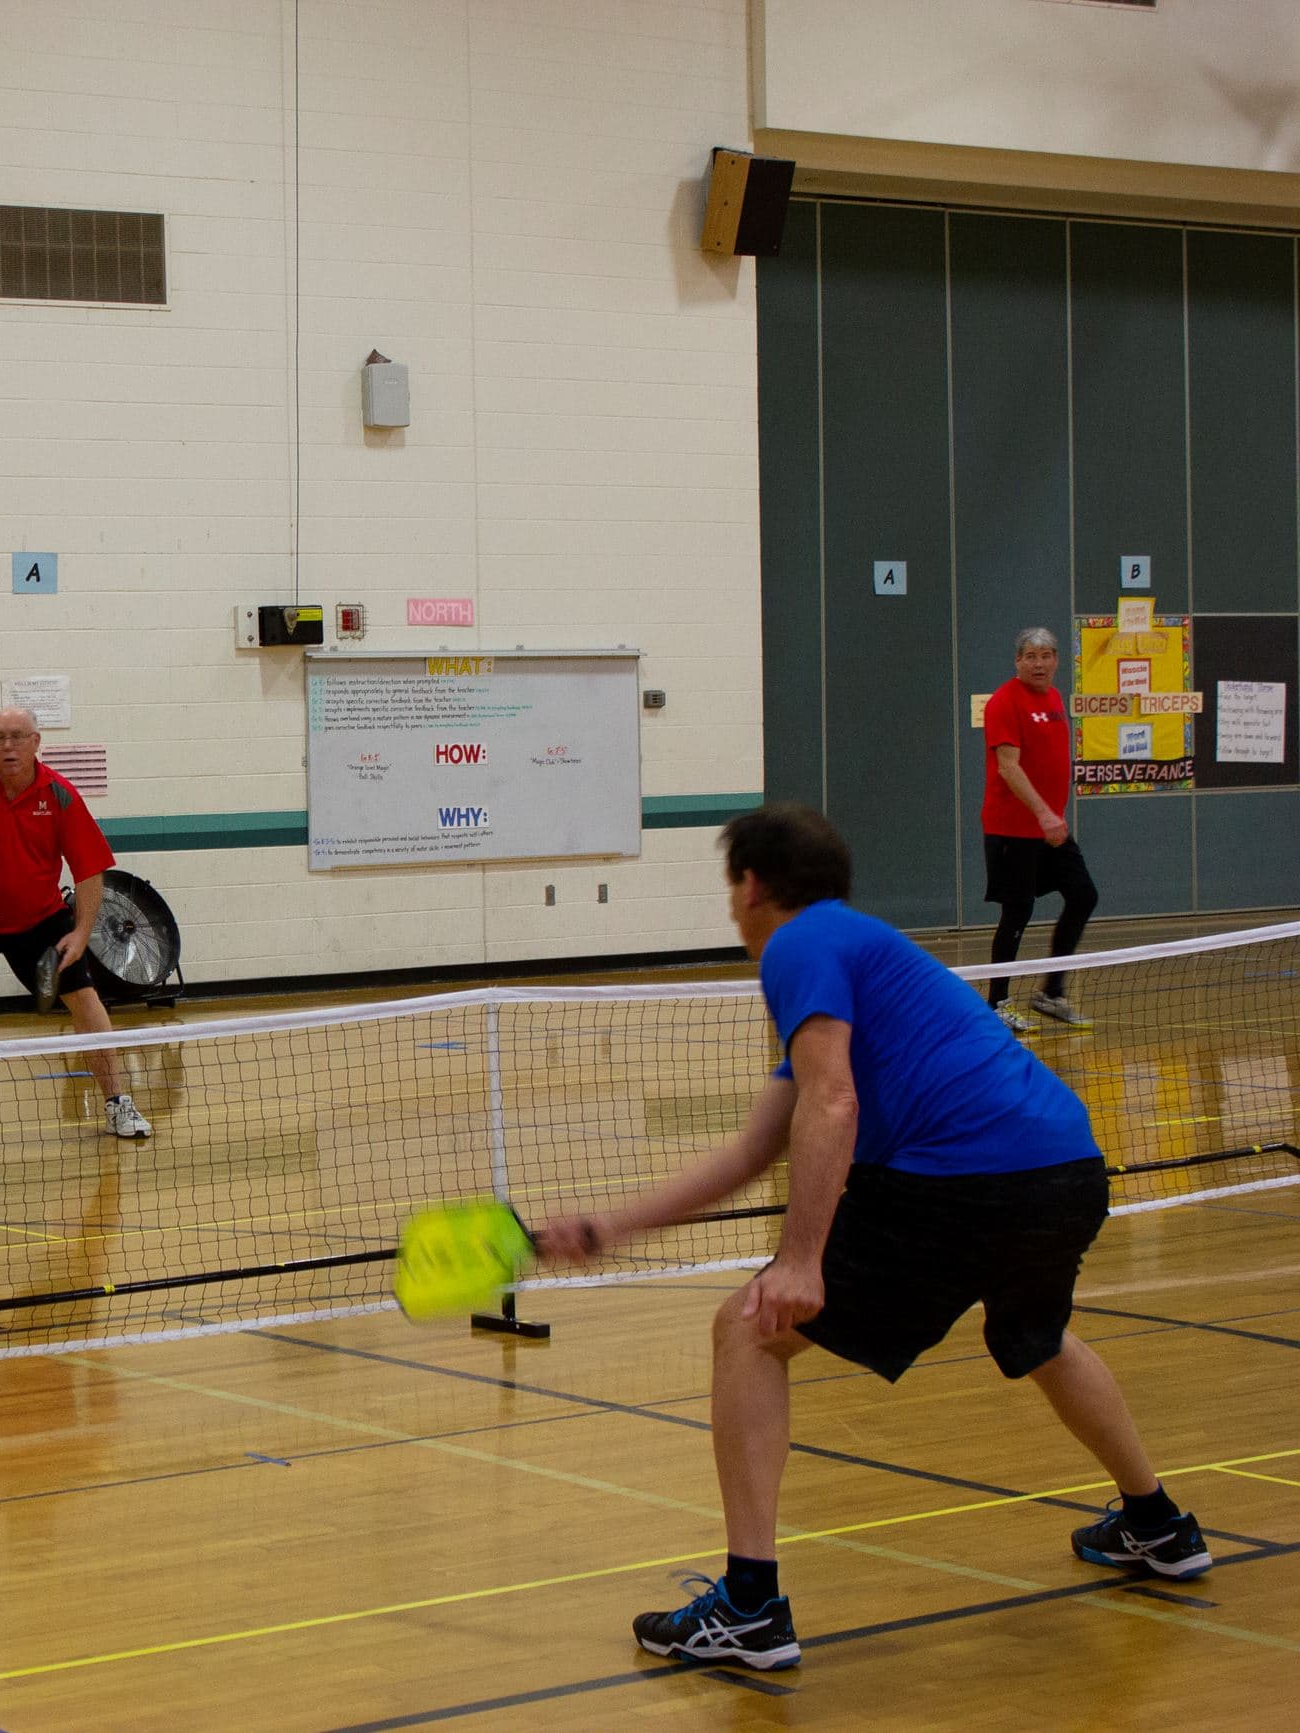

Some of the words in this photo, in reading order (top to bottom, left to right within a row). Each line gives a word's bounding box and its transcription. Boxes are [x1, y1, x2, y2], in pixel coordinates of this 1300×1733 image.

[26, 563, 40, 582] A
[883, 569, 894, 585] A
[1131, 564, 1141, 579] B
[410, 602, 471, 621] NORTH
[427, 656, 492, 675] WHAT:
[1074, 697, 1128, 713] BICEPS
[1141, 695, 1199, 712] TRICEPS
[436, 744, 486, 764] HOW:
[1074, 760, 1195, 782] PERSEVERANCE
[439, 807, 487, 828] WHY:
